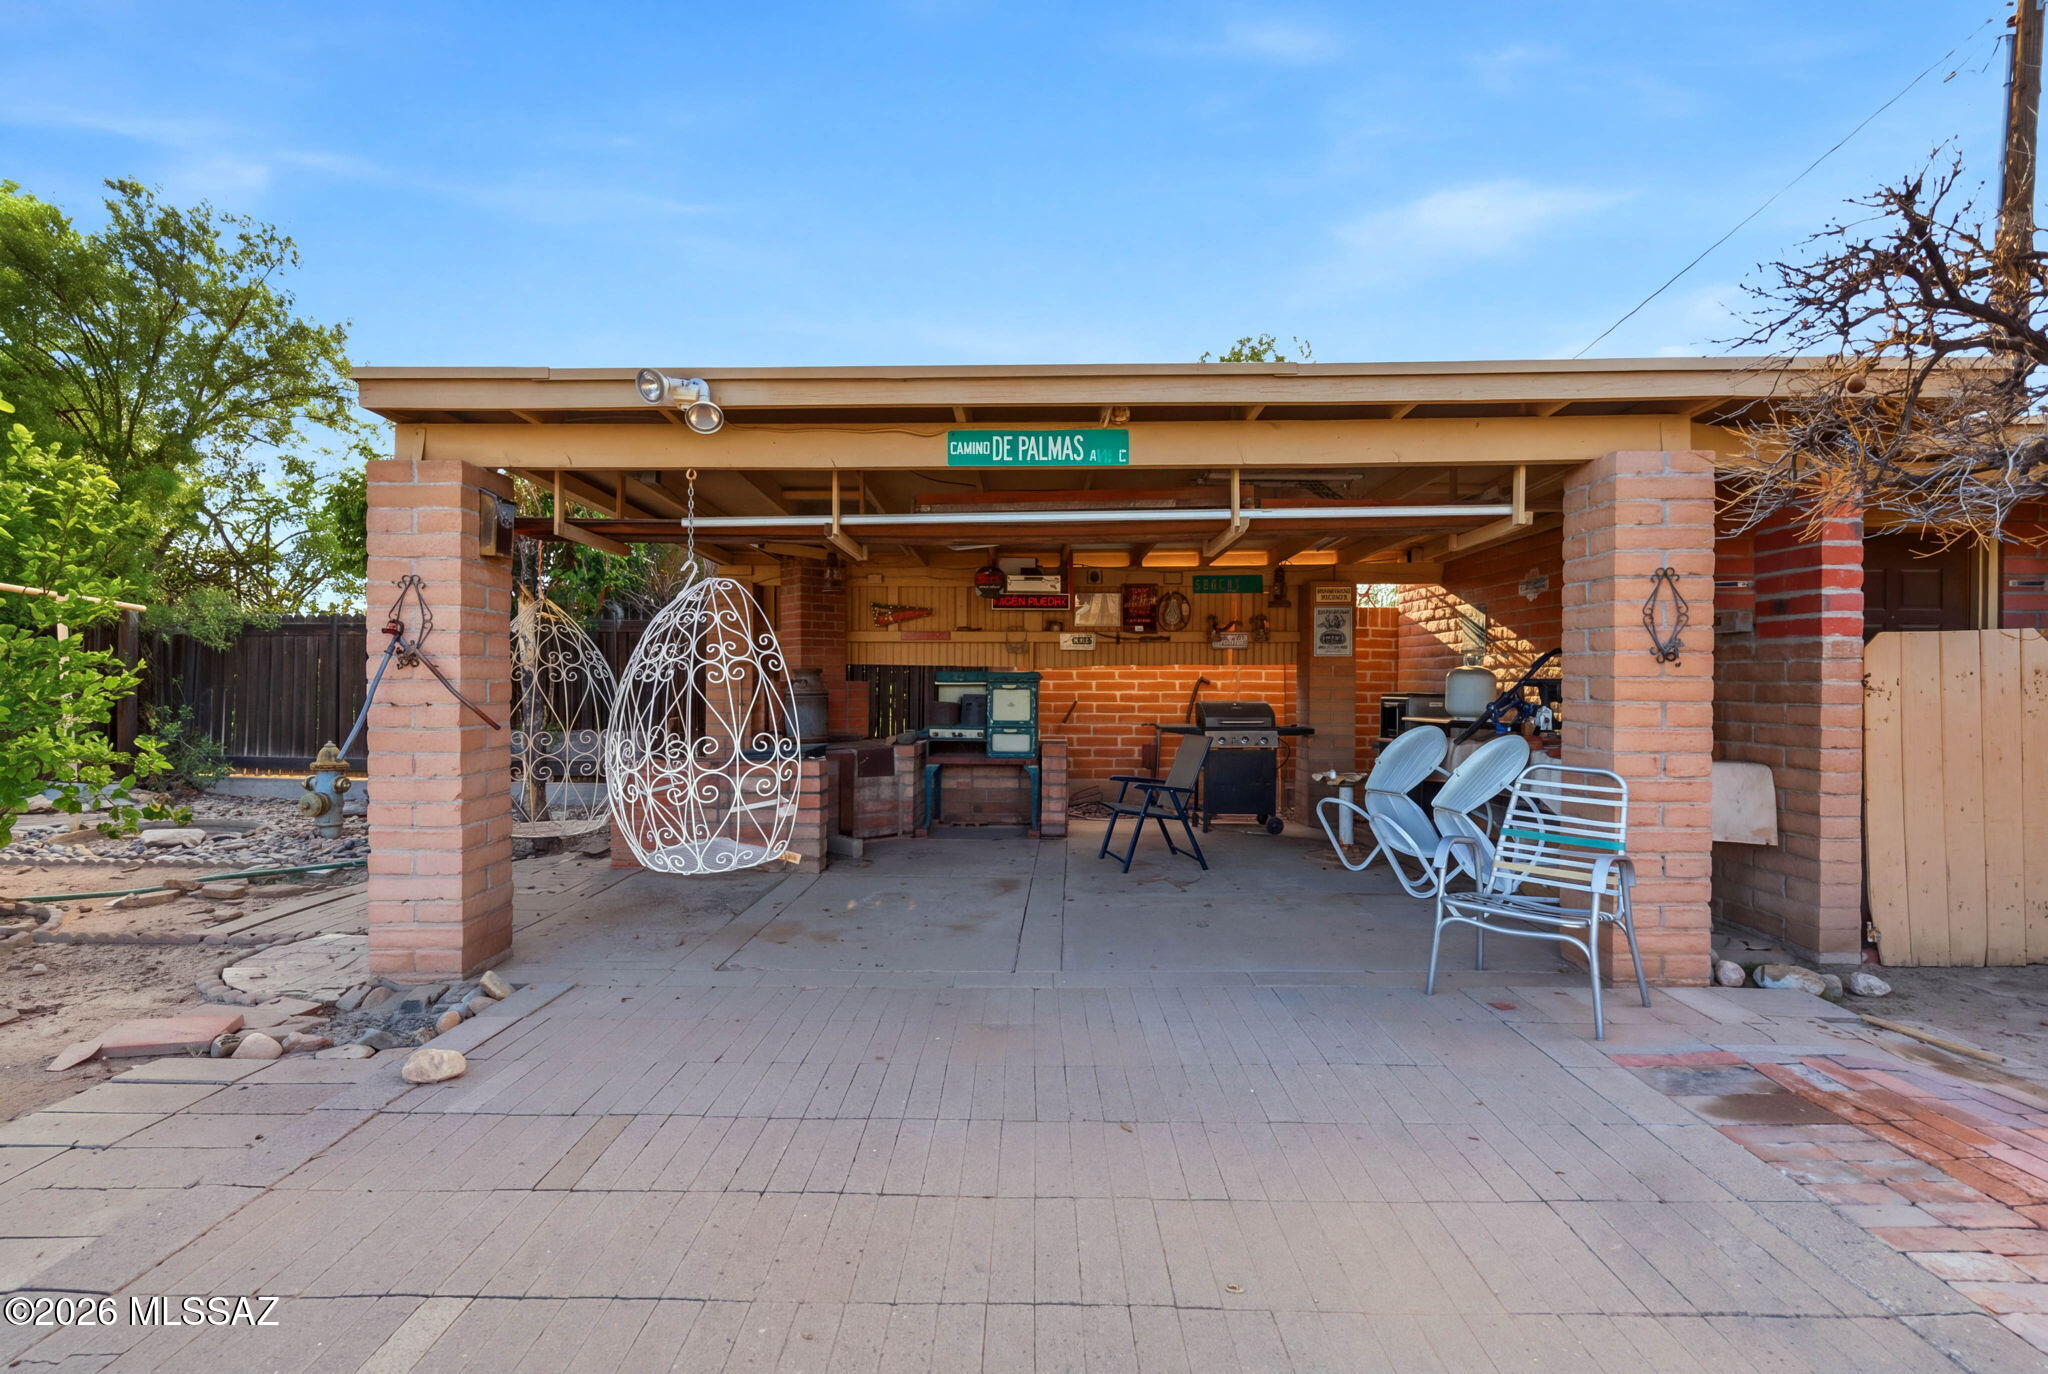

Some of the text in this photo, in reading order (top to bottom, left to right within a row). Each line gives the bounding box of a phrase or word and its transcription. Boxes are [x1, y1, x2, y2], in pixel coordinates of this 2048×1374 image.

[950, 441, 990, 455] CAMINO
[992, 436, 1013, 461] DE
[1018, 435, 1084, 461] PALMAS
